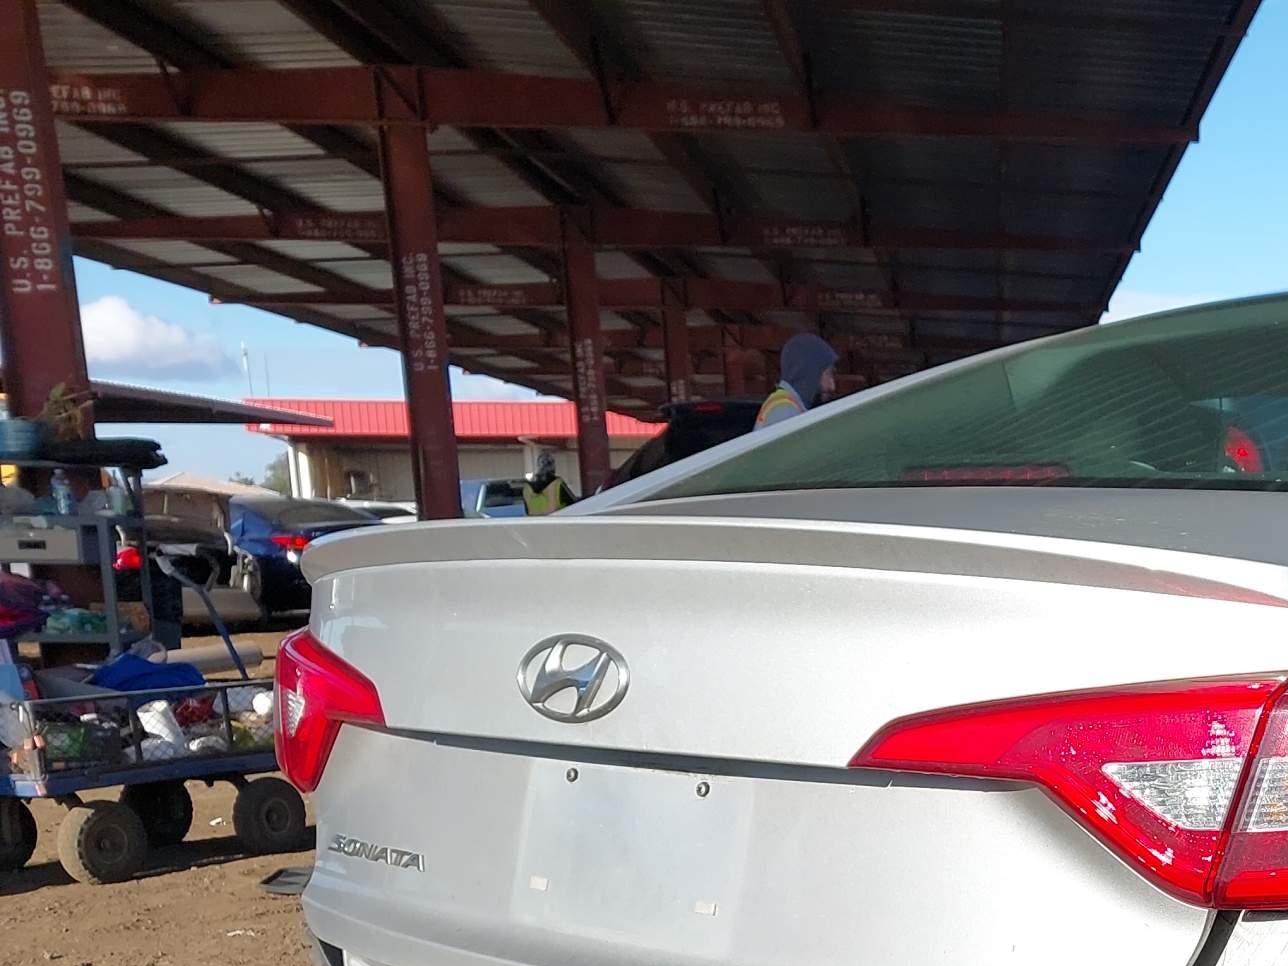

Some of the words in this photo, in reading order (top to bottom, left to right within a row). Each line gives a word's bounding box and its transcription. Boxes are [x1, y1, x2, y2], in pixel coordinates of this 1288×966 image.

[0, 146, 25, 237] PREFAB
[10, 90, 57, 292] 1-866-799-0969
[10, 250, 32, 293] U.S.
[327, 832, 425, 872] SONATA
